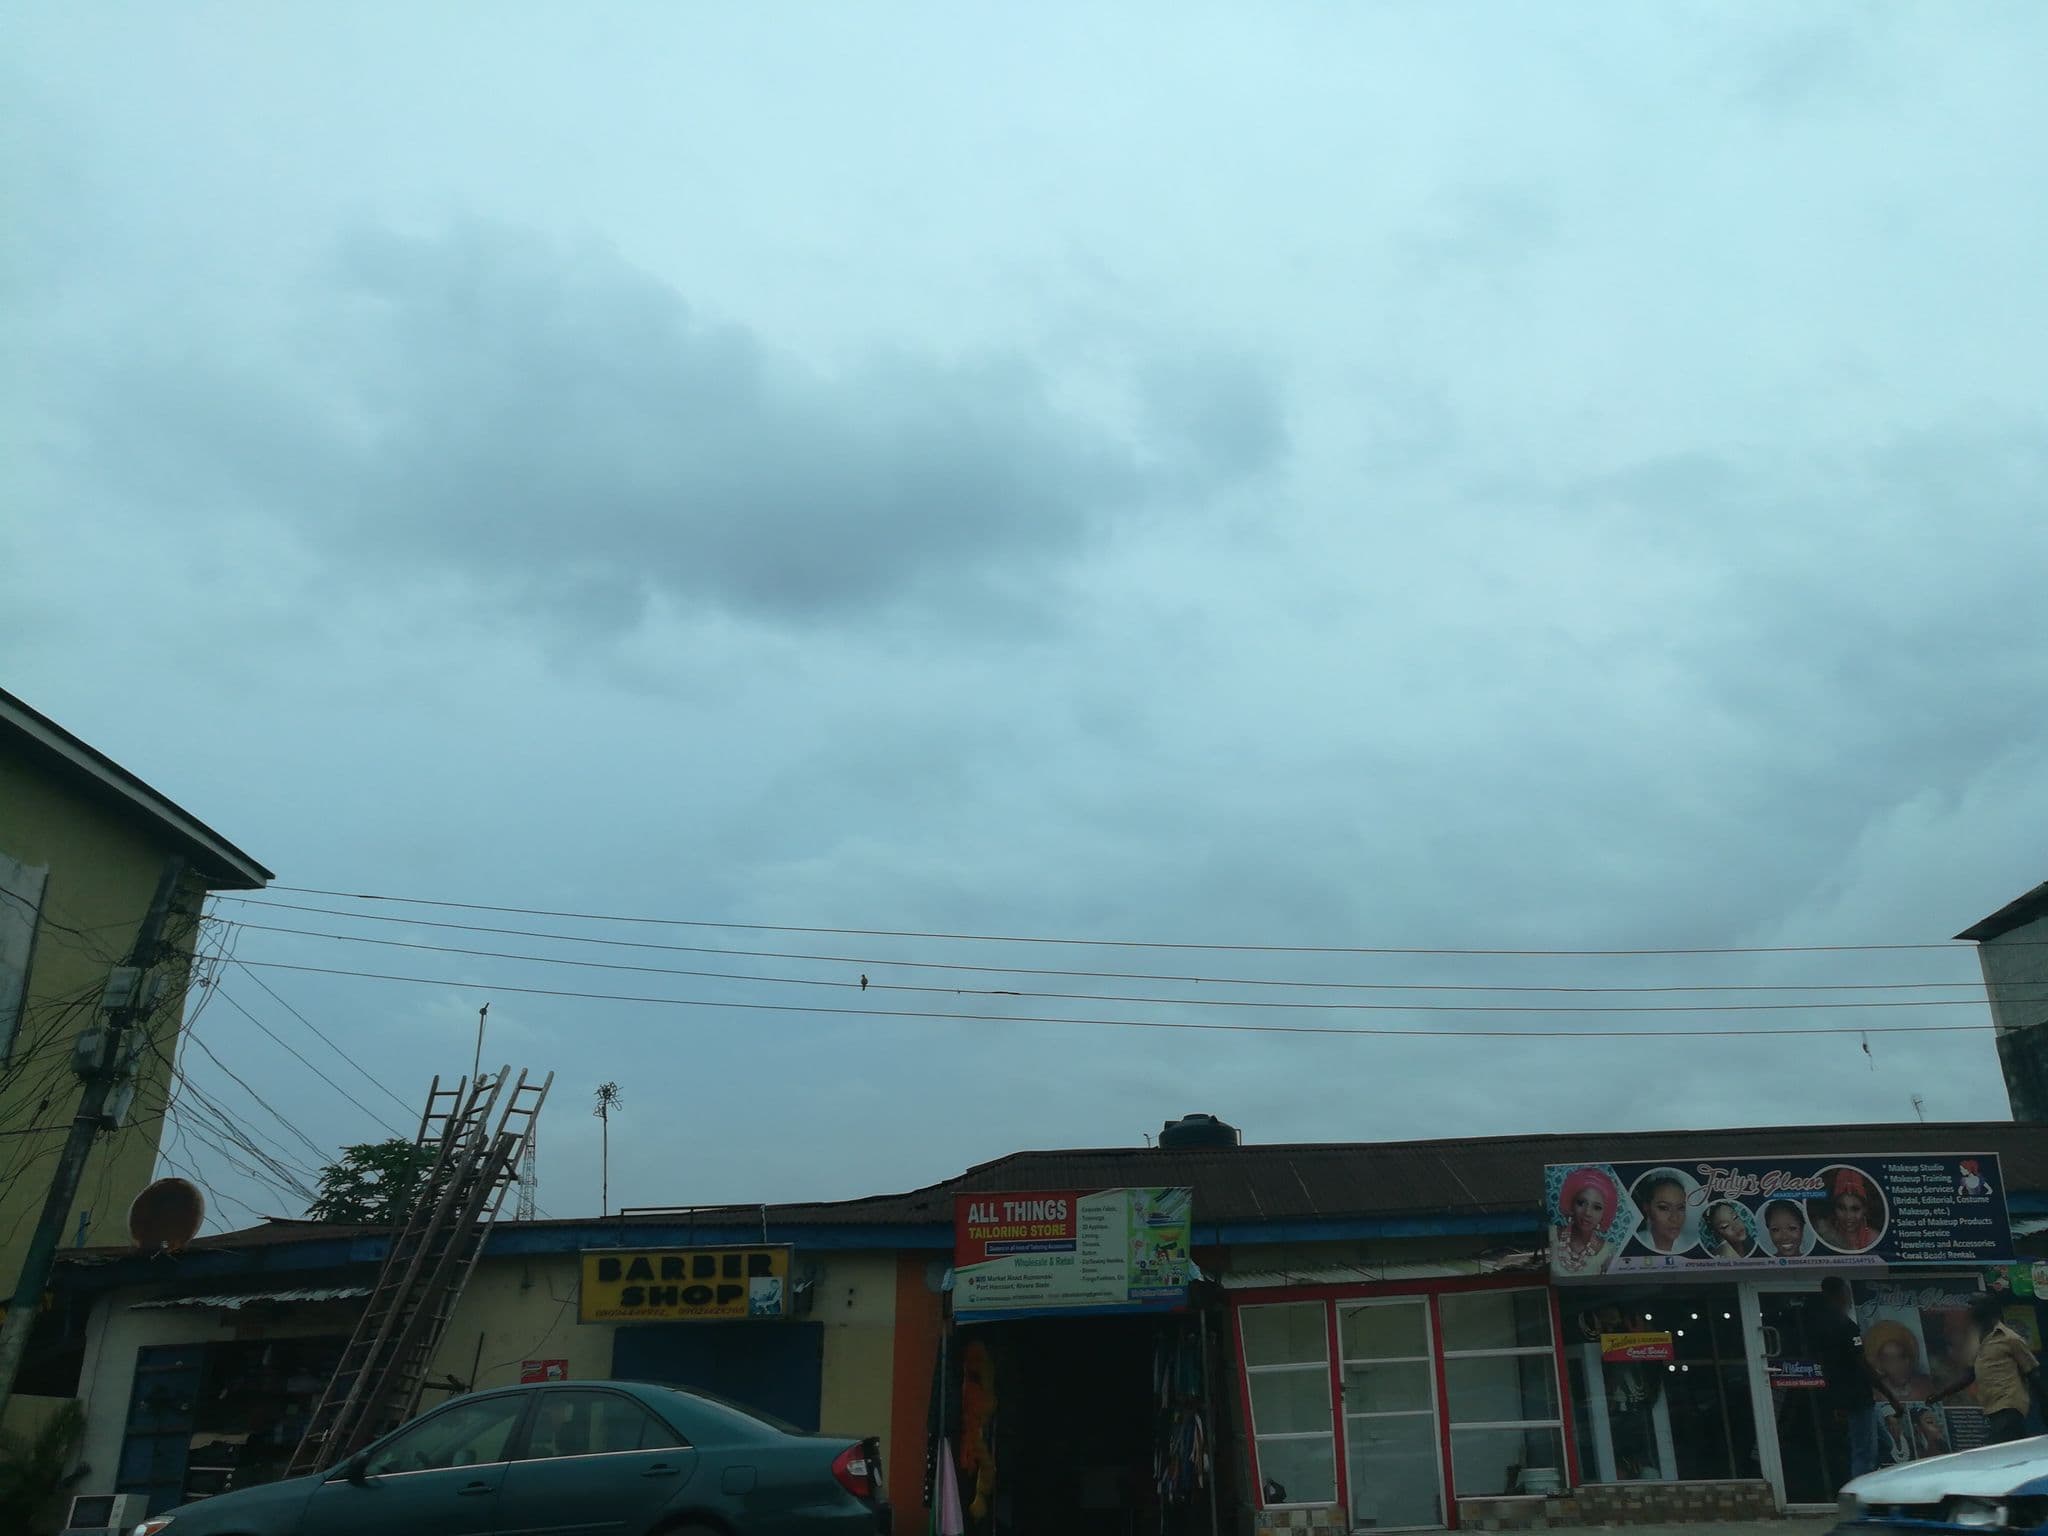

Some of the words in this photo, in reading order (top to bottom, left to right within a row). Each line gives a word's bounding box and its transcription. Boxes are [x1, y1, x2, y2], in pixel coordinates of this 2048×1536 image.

[1888, 1164, 1919, 1173] Makeup
[1920, 1163, 1945, 1172] Studio
[1688, 1163, 1760, 1206] Judy's
[1760, 1169, 1825, 1198] Glam
[1889, 1175, 1921, 1185] Makeup
[1921, 1174, 1952, 1184] Training
[1773, 1191, 1801, 1199] MAKEUP
[1801, 1190, 1827, 1198] STUDIO
[1891, 1186, 1923, 1195] Makeup
[1924, 1185, 1955, 1194] Services
[1957, 1196, 1991, 1204] Costume
[968, 1202, 1000, 1224] ALL
[1003, 1199, 1067, 1222] THINGS
[1896, 1218, 1917, 1227] Sales
[1918, 1218, 1927, 1226] of
[1927, 1218, 1959, 1228] Makeup
[1959, 1217, 1993, 1226] Products
[968, 1225, 1029, 1240] TAILORING
[1030, 1223, 1067, 1237] STORE
[1898, 1229, 1922, 1238] Home
[1923, 1229, 1952, 1237] Service
[1900, 1241, 1936, 1249] Jewelries
[1936, 1240, 1952, 1248] and
[1952, 1240, 1997, 1248] Accessories
[1902, 1251, 1923, 1260] Coral
[1923, 1251, 1947, 1259] Beads
[1947, 1250, 1977, 1259] Rentals
[1014, 1257, 1048, 1267] Wholesale
[1049, 1256, 1055, 1266] &
[1055, 1255, 1075, 1266] Retail
[598, 1254, 773, 1282] BARBER
[619, 1284, 743, 1307] SHOP
